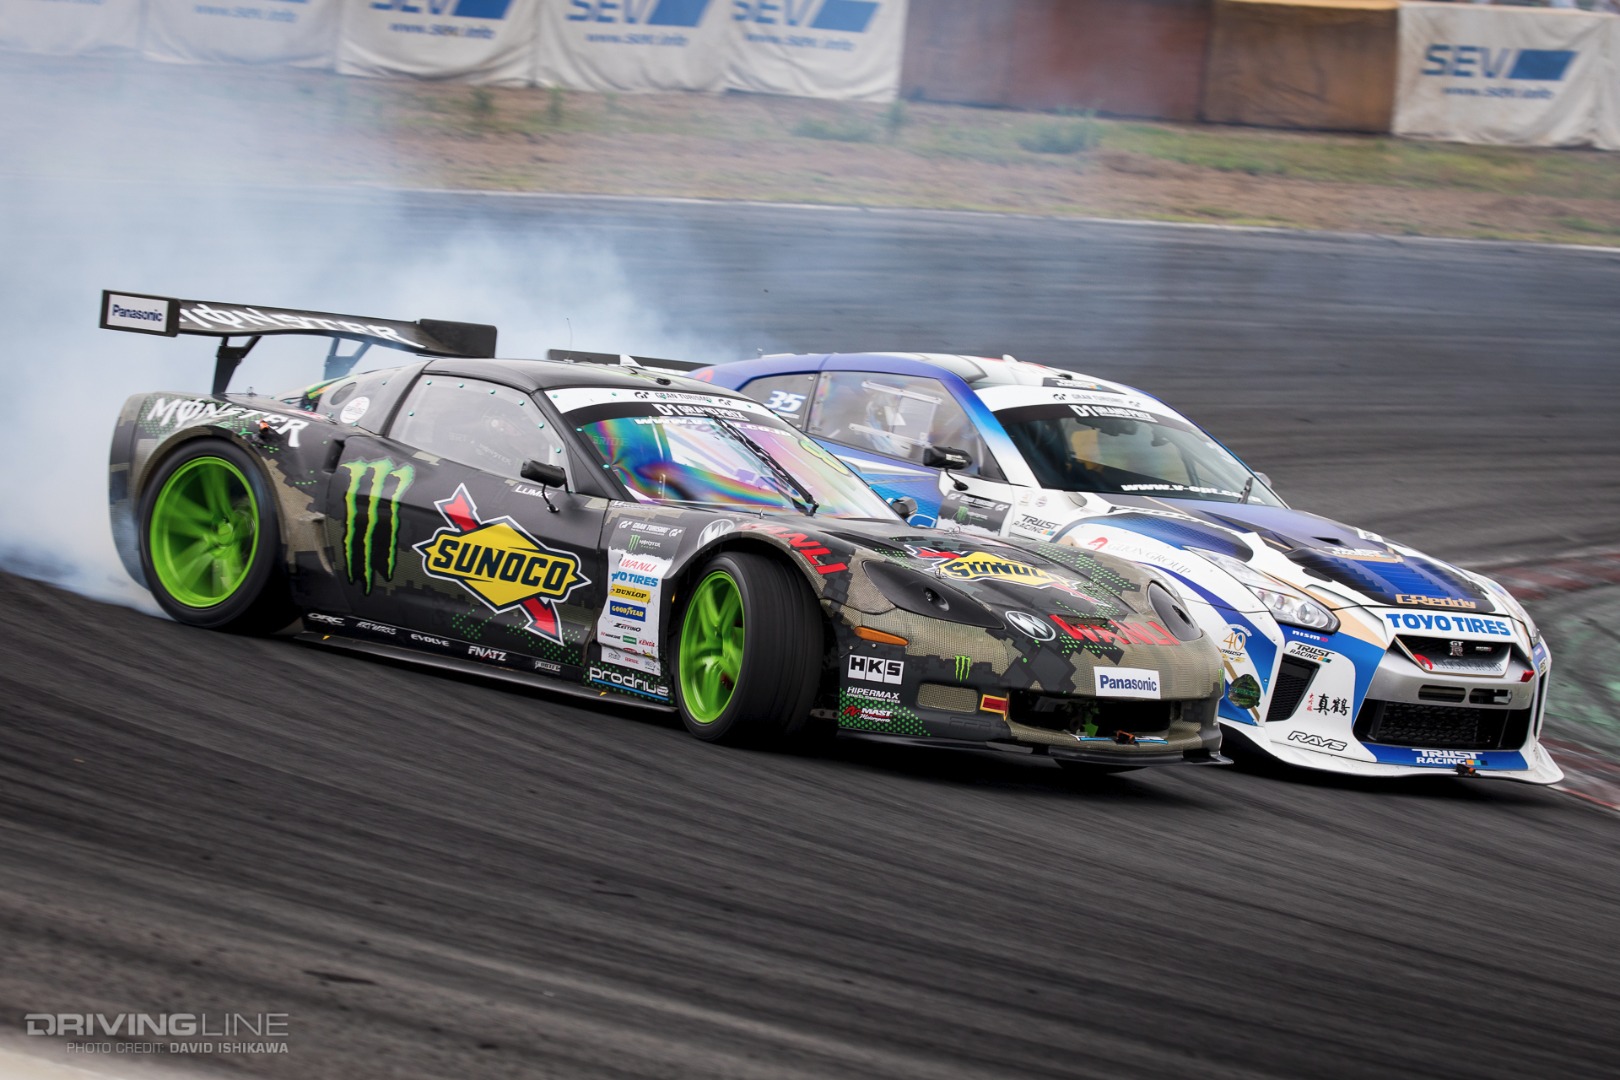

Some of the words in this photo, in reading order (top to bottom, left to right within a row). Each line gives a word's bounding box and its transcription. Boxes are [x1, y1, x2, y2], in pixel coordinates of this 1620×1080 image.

[1421, 43, 1512, 79] SEV
[112, 304, 163, 322] Panasonic
[651, 403, 684, 415] D1
[768, 390, 807, 413] 35
[1068, 404, 1099, 417] D1
[1012, 521, 1042, 534] RACING
[432, 538, 571, 591] SUNOCO
[620, 558, 657, 573] WANLI
[628, 573, 658, 587] TIRES
[616, 588, 647, 599] DUNLOP
[1048, 614, 1181, 645] WANLI
[1386, 613, 1452, 631] TOYO
[1451, 616, 1511, 636] TIRES
[410, 633, 450, 647] EVOLVE
[1223, 632, 1247, 651] 40
[1290, 648, 1318, 660] RACING
[1294, 642, 1335, 657] TRUST
[850, 657, 901, 676] HKS
[589, 666, 669, 697] prodrive
[1099, 674, 1157, 692] Panasonic
[846, 686, 900, 700] HIPERMAX
[861, 707, 893, 717] MAST
[1287, 730, 1348, 752] RAYS
[1411, 748, 1483, 760] TRUST
[1416, 756, 1467, 765] RACING
